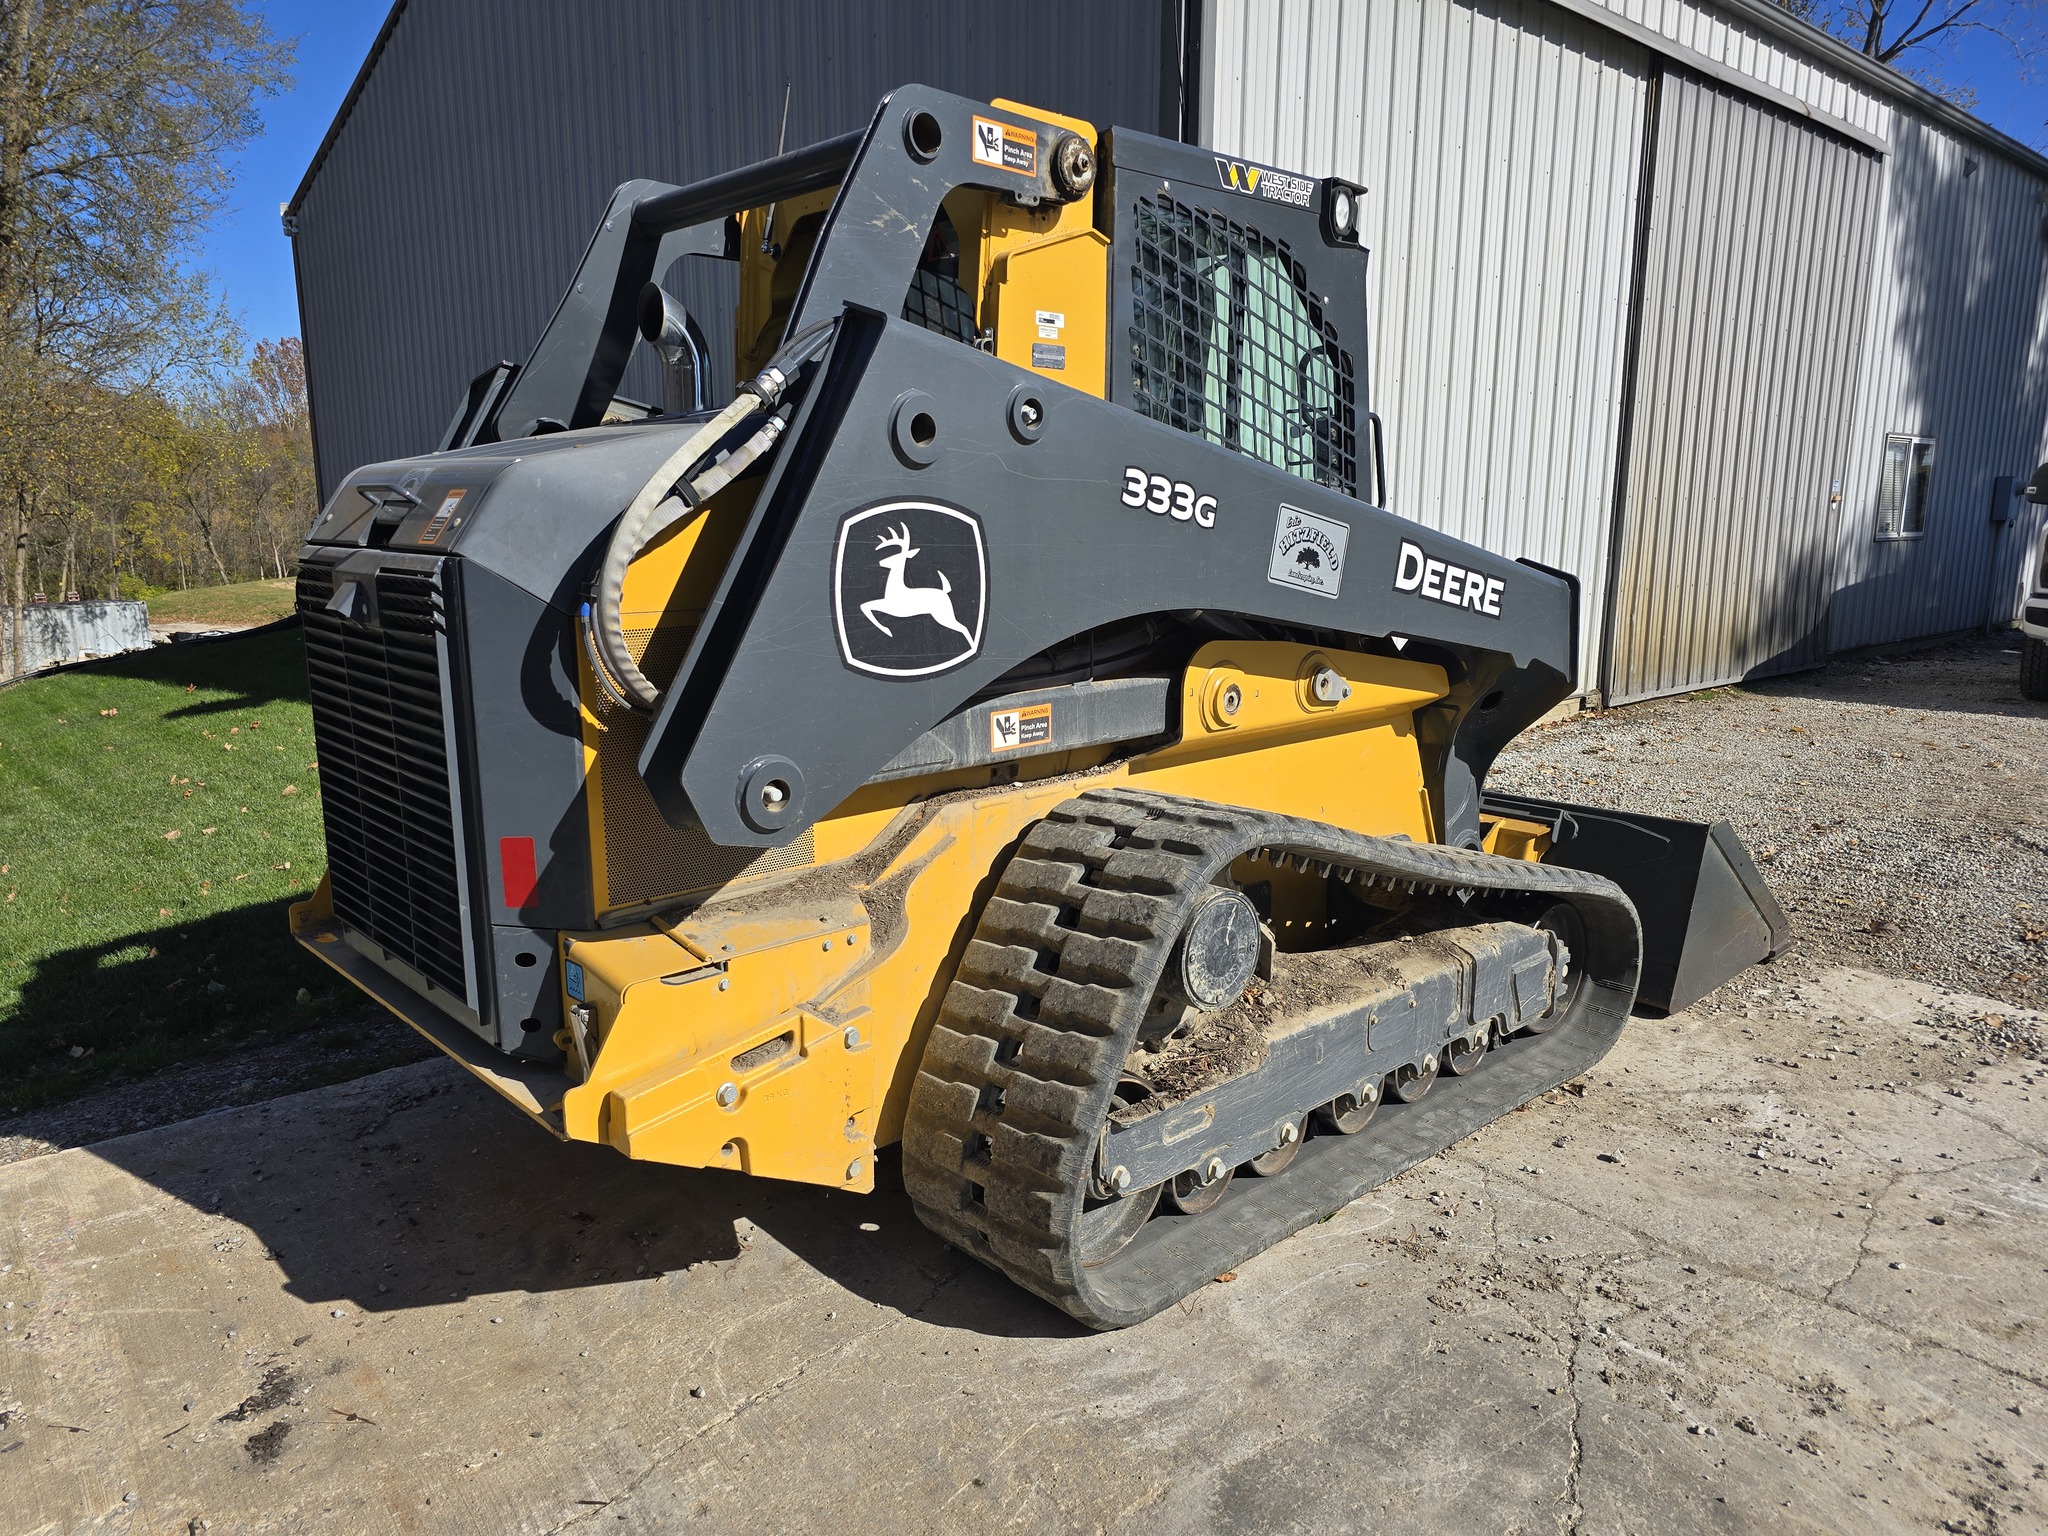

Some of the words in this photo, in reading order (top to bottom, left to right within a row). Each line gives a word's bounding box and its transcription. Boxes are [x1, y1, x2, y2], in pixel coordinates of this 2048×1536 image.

[1004, 144, 1020, 155] Pinch
[1020, 149, 1033, 159] Area
[1004, 154, 1016, 164] Keep
[1016, 158, 1029, 168] Away
[1261, 182, 1310, 207] TRACTOR
[1121, 466, 1218, 529] 333G
[1286, 515, 1302, 528] Eric
[1279, 527, 1339, 571] HITZFIELD
[1394, 541, 1505, 616] DEERE
[1026, 707, 1049, 716] WARNING
